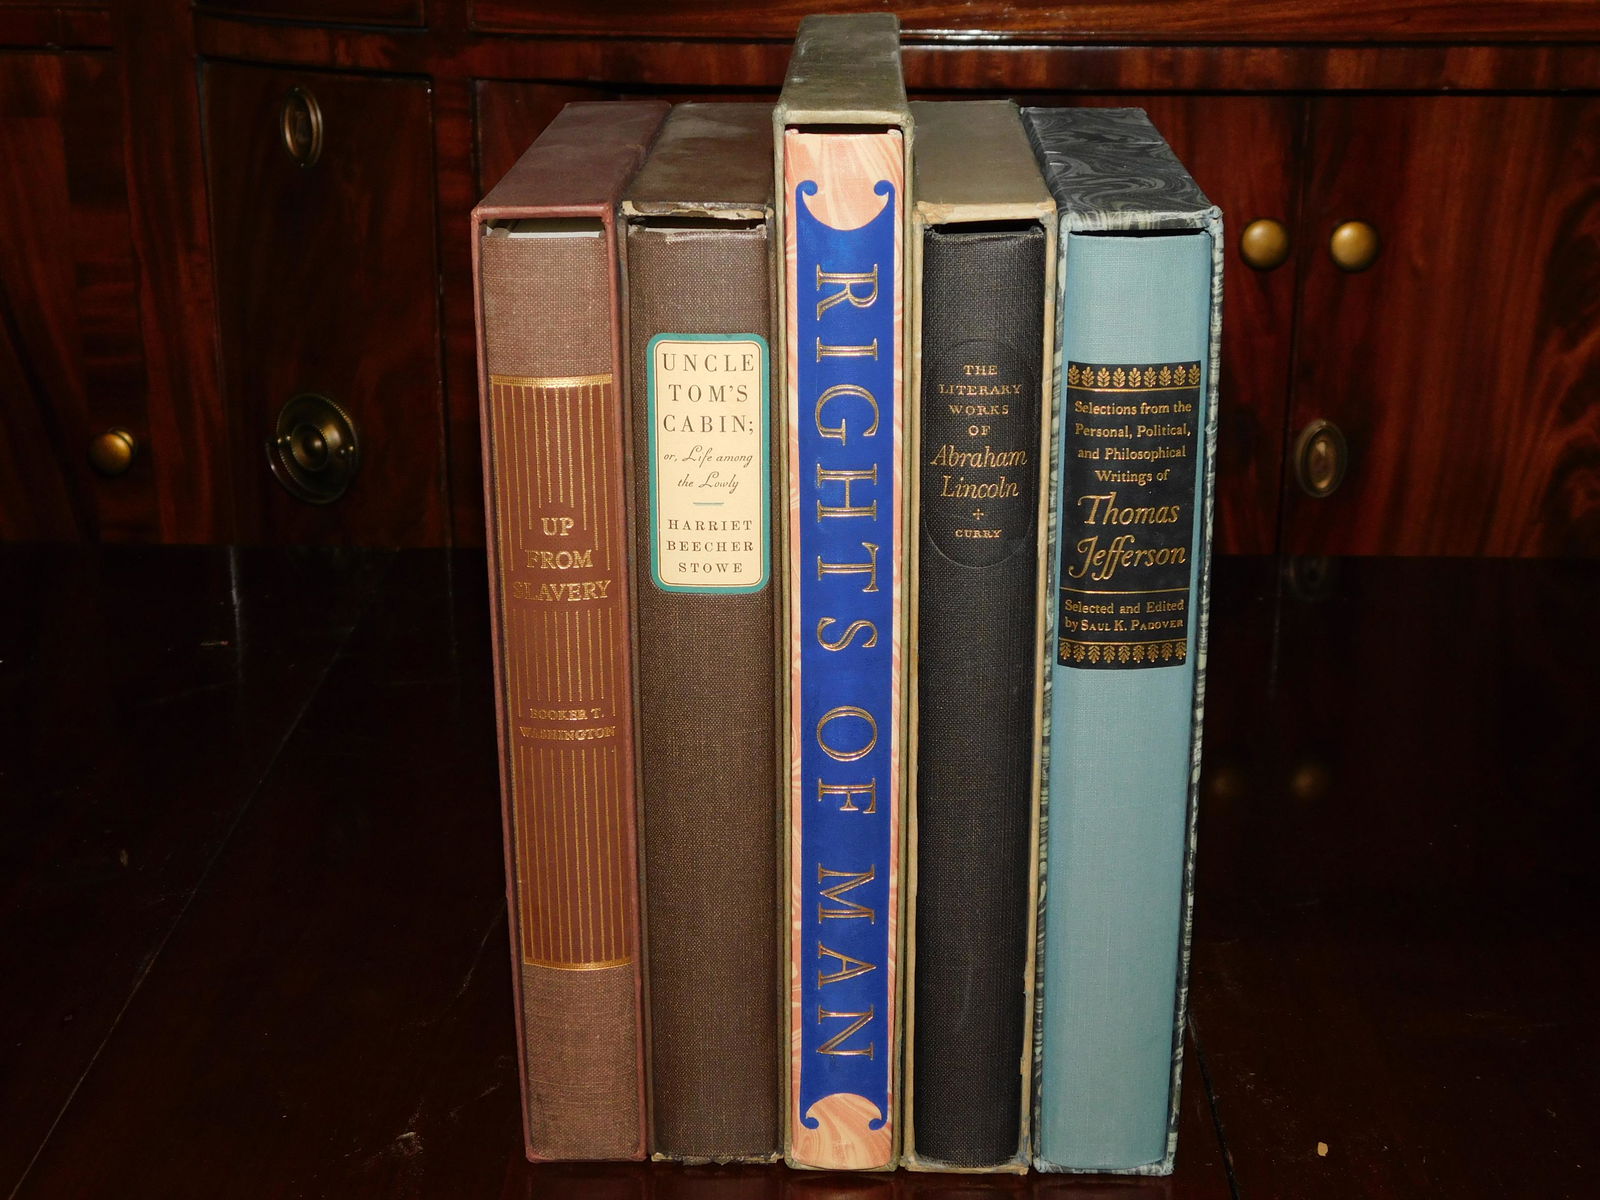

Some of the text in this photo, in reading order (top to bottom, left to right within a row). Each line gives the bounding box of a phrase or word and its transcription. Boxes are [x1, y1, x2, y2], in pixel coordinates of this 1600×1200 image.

[662, 353, 754, 372] UNCLE
[963, 365, 998, 375] THE
[668, 384, 748, 402] TOM'S
[939, 384, 1022, 395] LITERARY
[949, 404, 1009, 415] WORKS
[1074, 400, 1192, 415] Selections from the
[663, 414, 754, 435] CABIN;
[968, 425, 990, 436] OF
[1074, 423, 1191, 439] Personal, Political,
[664, 445, 753, 468] or, Life among
[930, 444, 1027, 468] Abraham
[1078, 445, 1186, 462] and Philosophical
[678, 471, 739, 494] the Lowly
[1095, 469, 1170, 486] Writings of
[940, 475, 1019, 498] Lincoln
[1077, 492, 1180, 525] Thomas
[541, 517, 575, 536] UP
[668, 519, 752, 531] HARRIET
[955, 529, 1002, 538] CURRY
[666, 541, 753, 551] BEECHER
[525, 549, 593, 569] FROM
[1068, 534, 1186, 580] Jefferson
[678, 562, 743, 573] STOWE
[513, 580, 611, 601] SLAVERY
[1065, 600, 1184, 614] Selected and Edited
[1065, 616, 1183, 632] by SAUL K. PADOVER
[814, 263, 879, 1061] RIGHTS OF MAN
[529, 708, 604, 720] BOOKER T.
[520, 726, 615, 740] WASHINGTON
